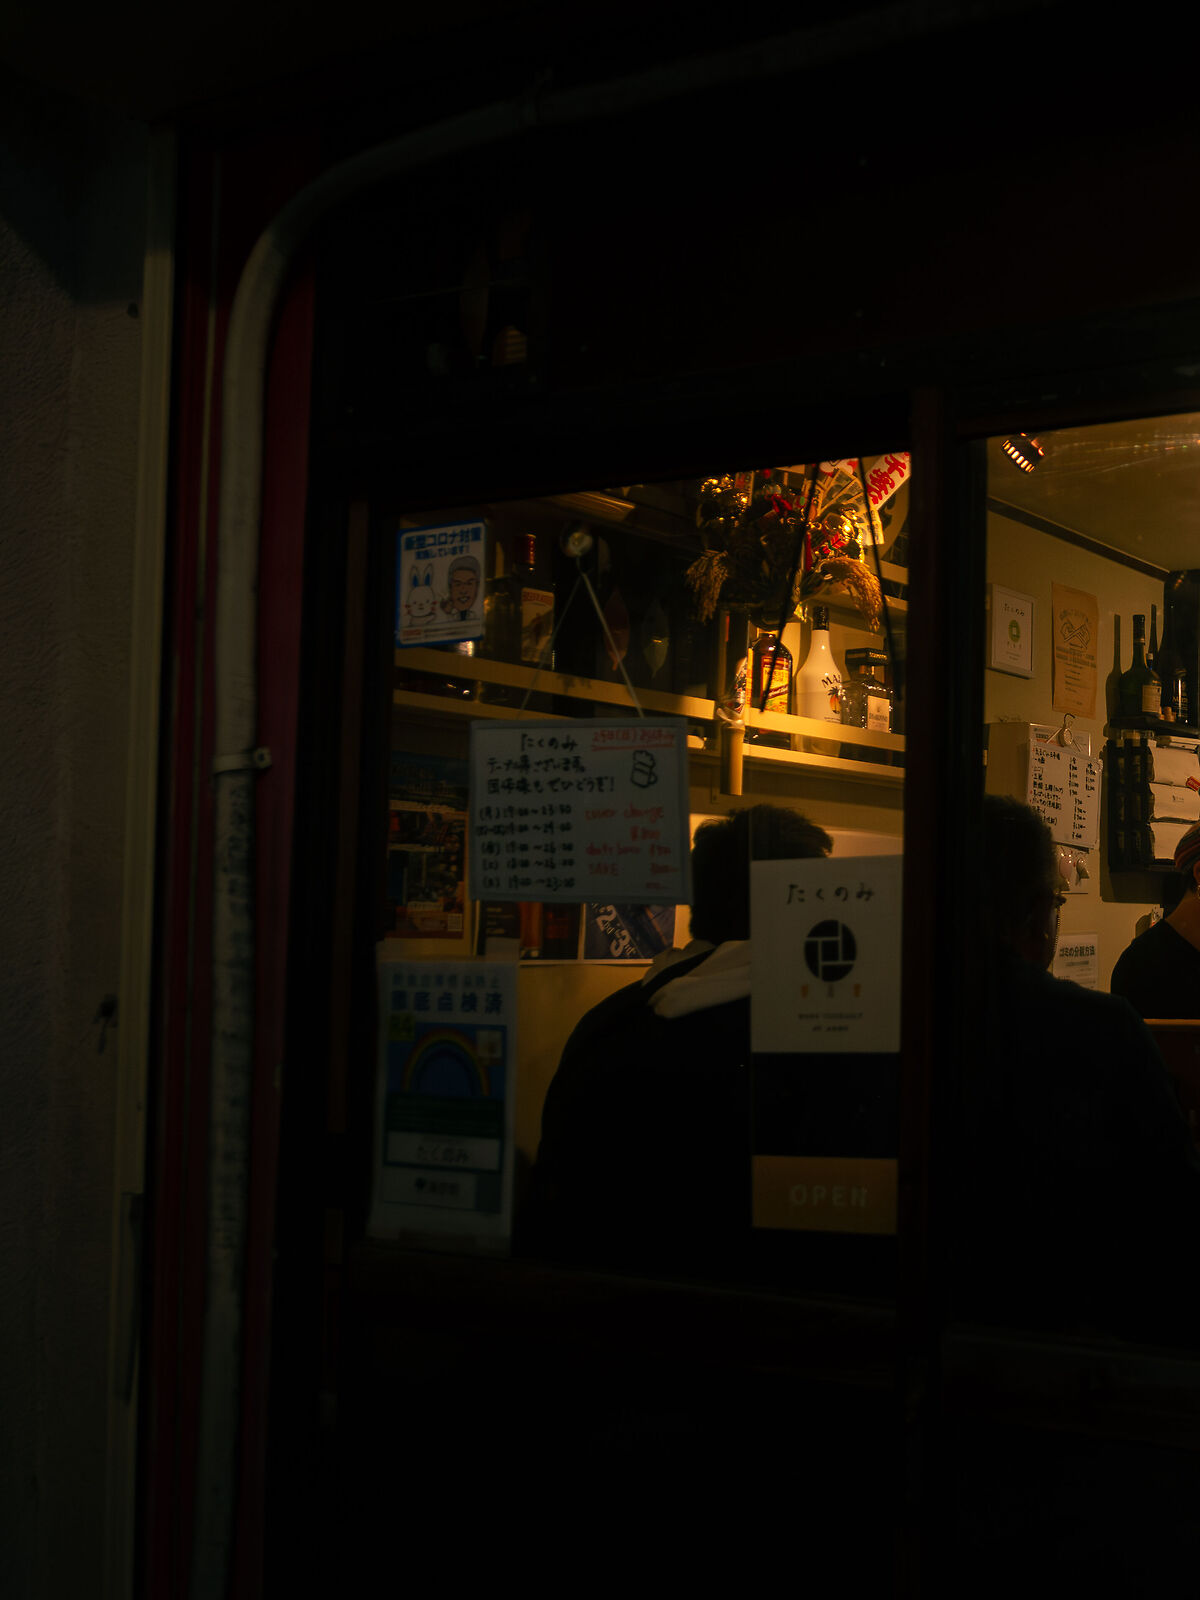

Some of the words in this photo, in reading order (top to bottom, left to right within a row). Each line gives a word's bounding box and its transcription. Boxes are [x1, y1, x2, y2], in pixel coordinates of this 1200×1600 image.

[520, 733, 578, 751] たくのみ
[623, 802, 665, 823] charge
[787, 883, 875, 904] たくのみ
[789, 1183, 869, 1208] OPEN
